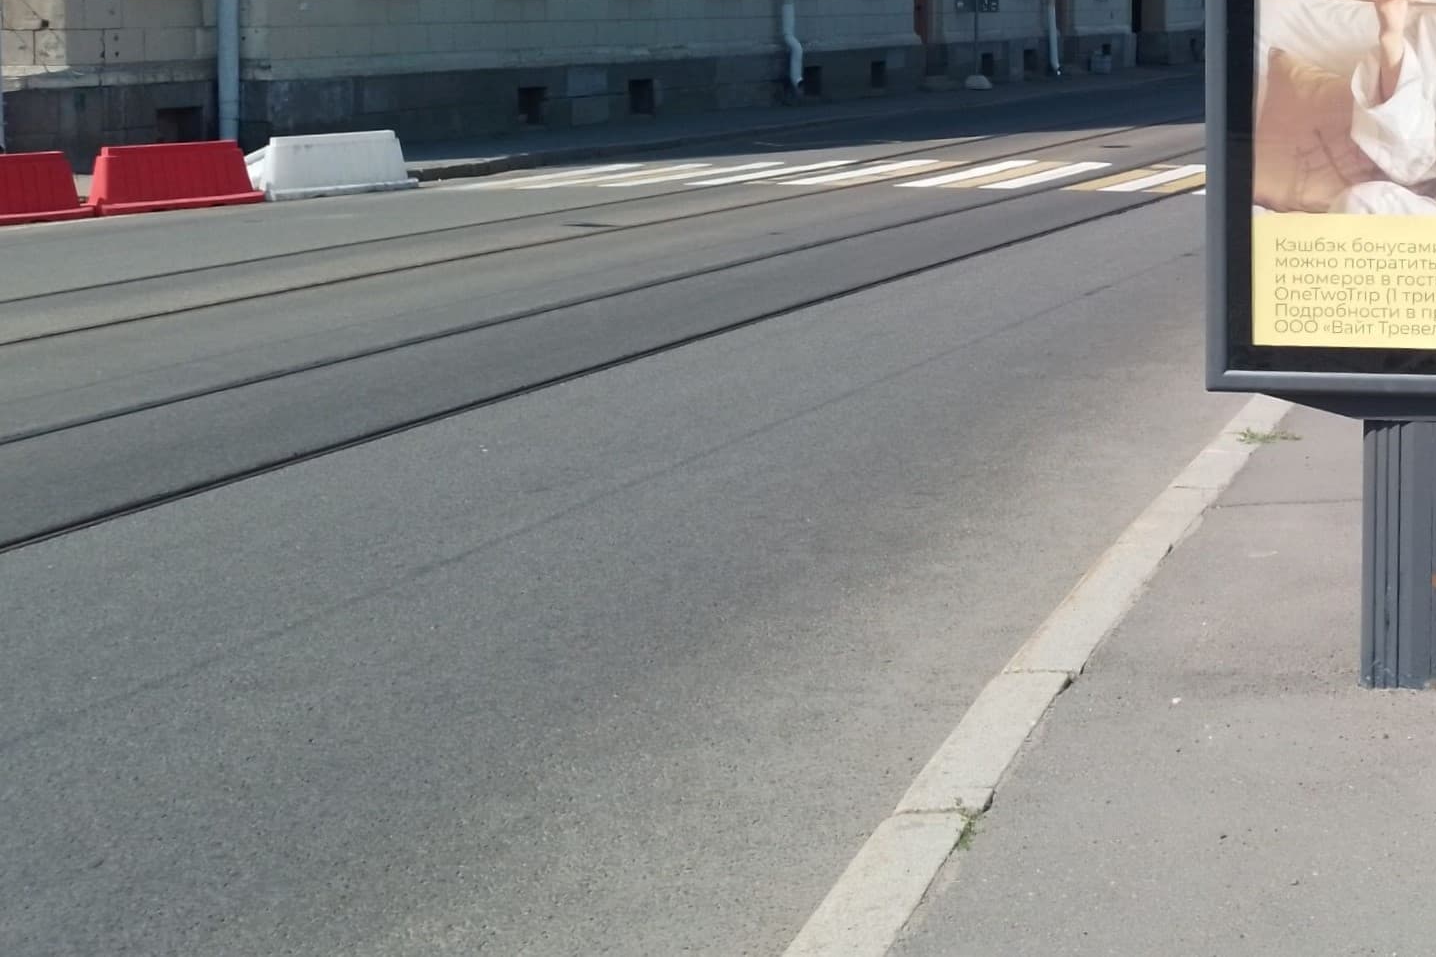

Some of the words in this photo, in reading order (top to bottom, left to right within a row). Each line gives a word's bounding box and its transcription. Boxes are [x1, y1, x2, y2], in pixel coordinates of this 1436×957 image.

[1275, 237, 1347, 253] Кэшбэк
[1275, 256, 1338, 269] можно
[1275, 273, 1286, 284] и
[1292, 273, 1375, 288] номеров
[1381, 274, 1391, 286] в
[1274, 286, 1381, 303] OneTwoTrip
[1386, 288, 1397, 304] (1
[1275, 303, 1400, 320] Подробности
[1406, 308, 1416, 318] в
[1274, 319, 1319, 334] ООО
[1323, 320, 1374, 335] «Вайт
